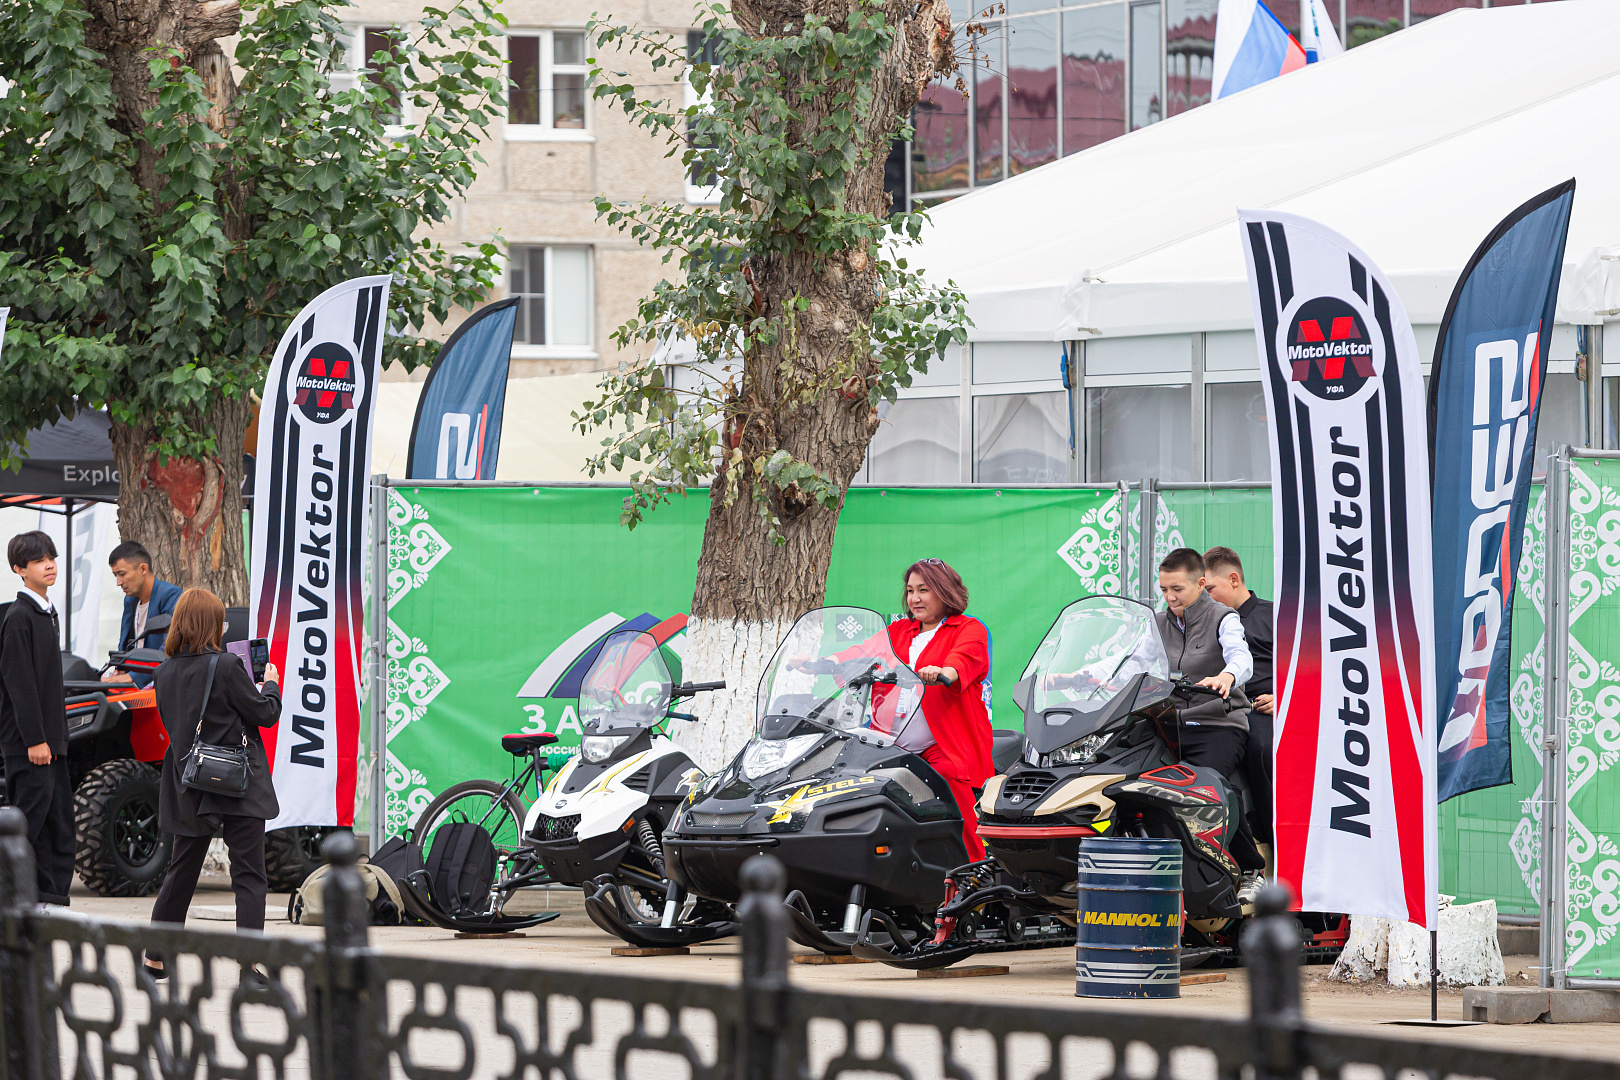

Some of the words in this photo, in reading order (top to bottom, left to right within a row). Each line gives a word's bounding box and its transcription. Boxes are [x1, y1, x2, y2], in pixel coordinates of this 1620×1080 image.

[1288, 341, 1372, 360] MotoVektor
[296, 376, 356, 392] MotoVektor
[1326, 384, 1345, 394] УФА
[289, 443, 334, 769] MotoVektor
[1326, 425, 1372, 839] MotoVektor
[807, 776, 874, 797] STELS
[1083, 911, 1162, 927] MANNOL
